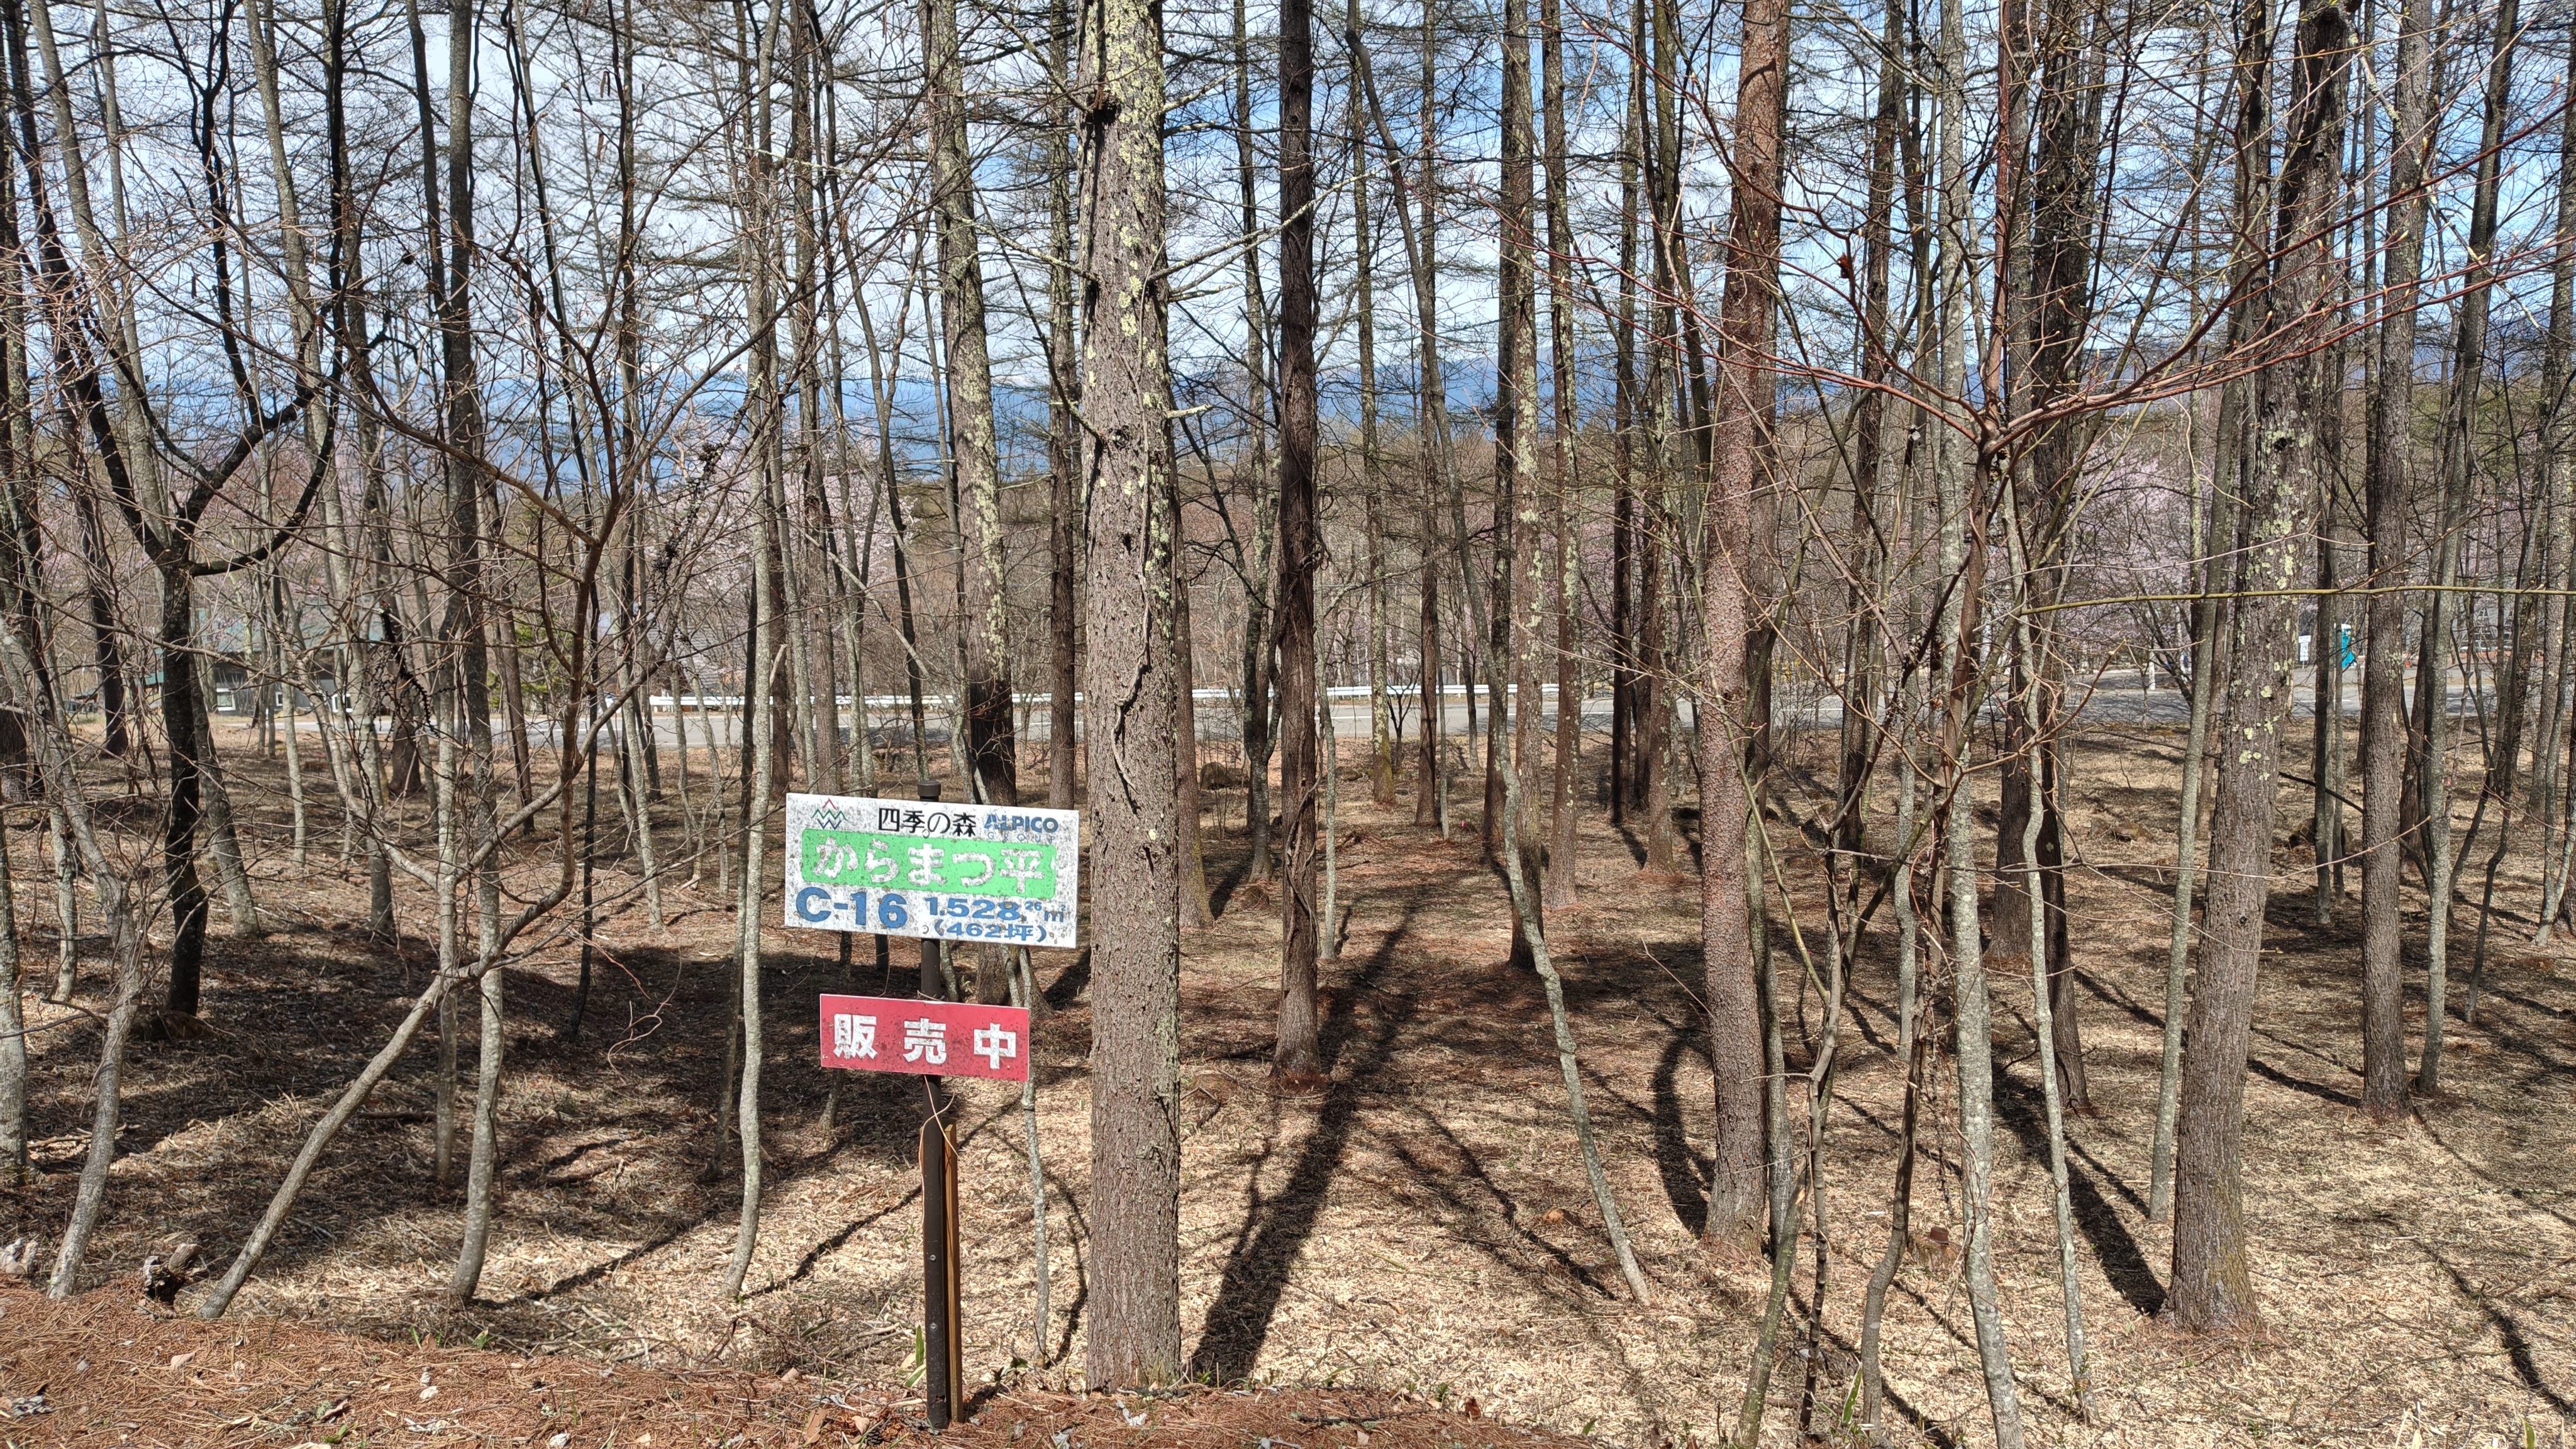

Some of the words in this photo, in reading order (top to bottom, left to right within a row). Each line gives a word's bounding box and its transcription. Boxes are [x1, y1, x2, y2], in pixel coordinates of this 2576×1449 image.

[878, 808, 977, 837] 四季の森
[984, 814, 1059, 833] ALPICO
[987, 831, 1056, 844] GROUP
[814, 836, 1045, 894] からまつ平
[796, 886, 908, 929] C-16
[833, 1013, 1016, 1069] 販売中
